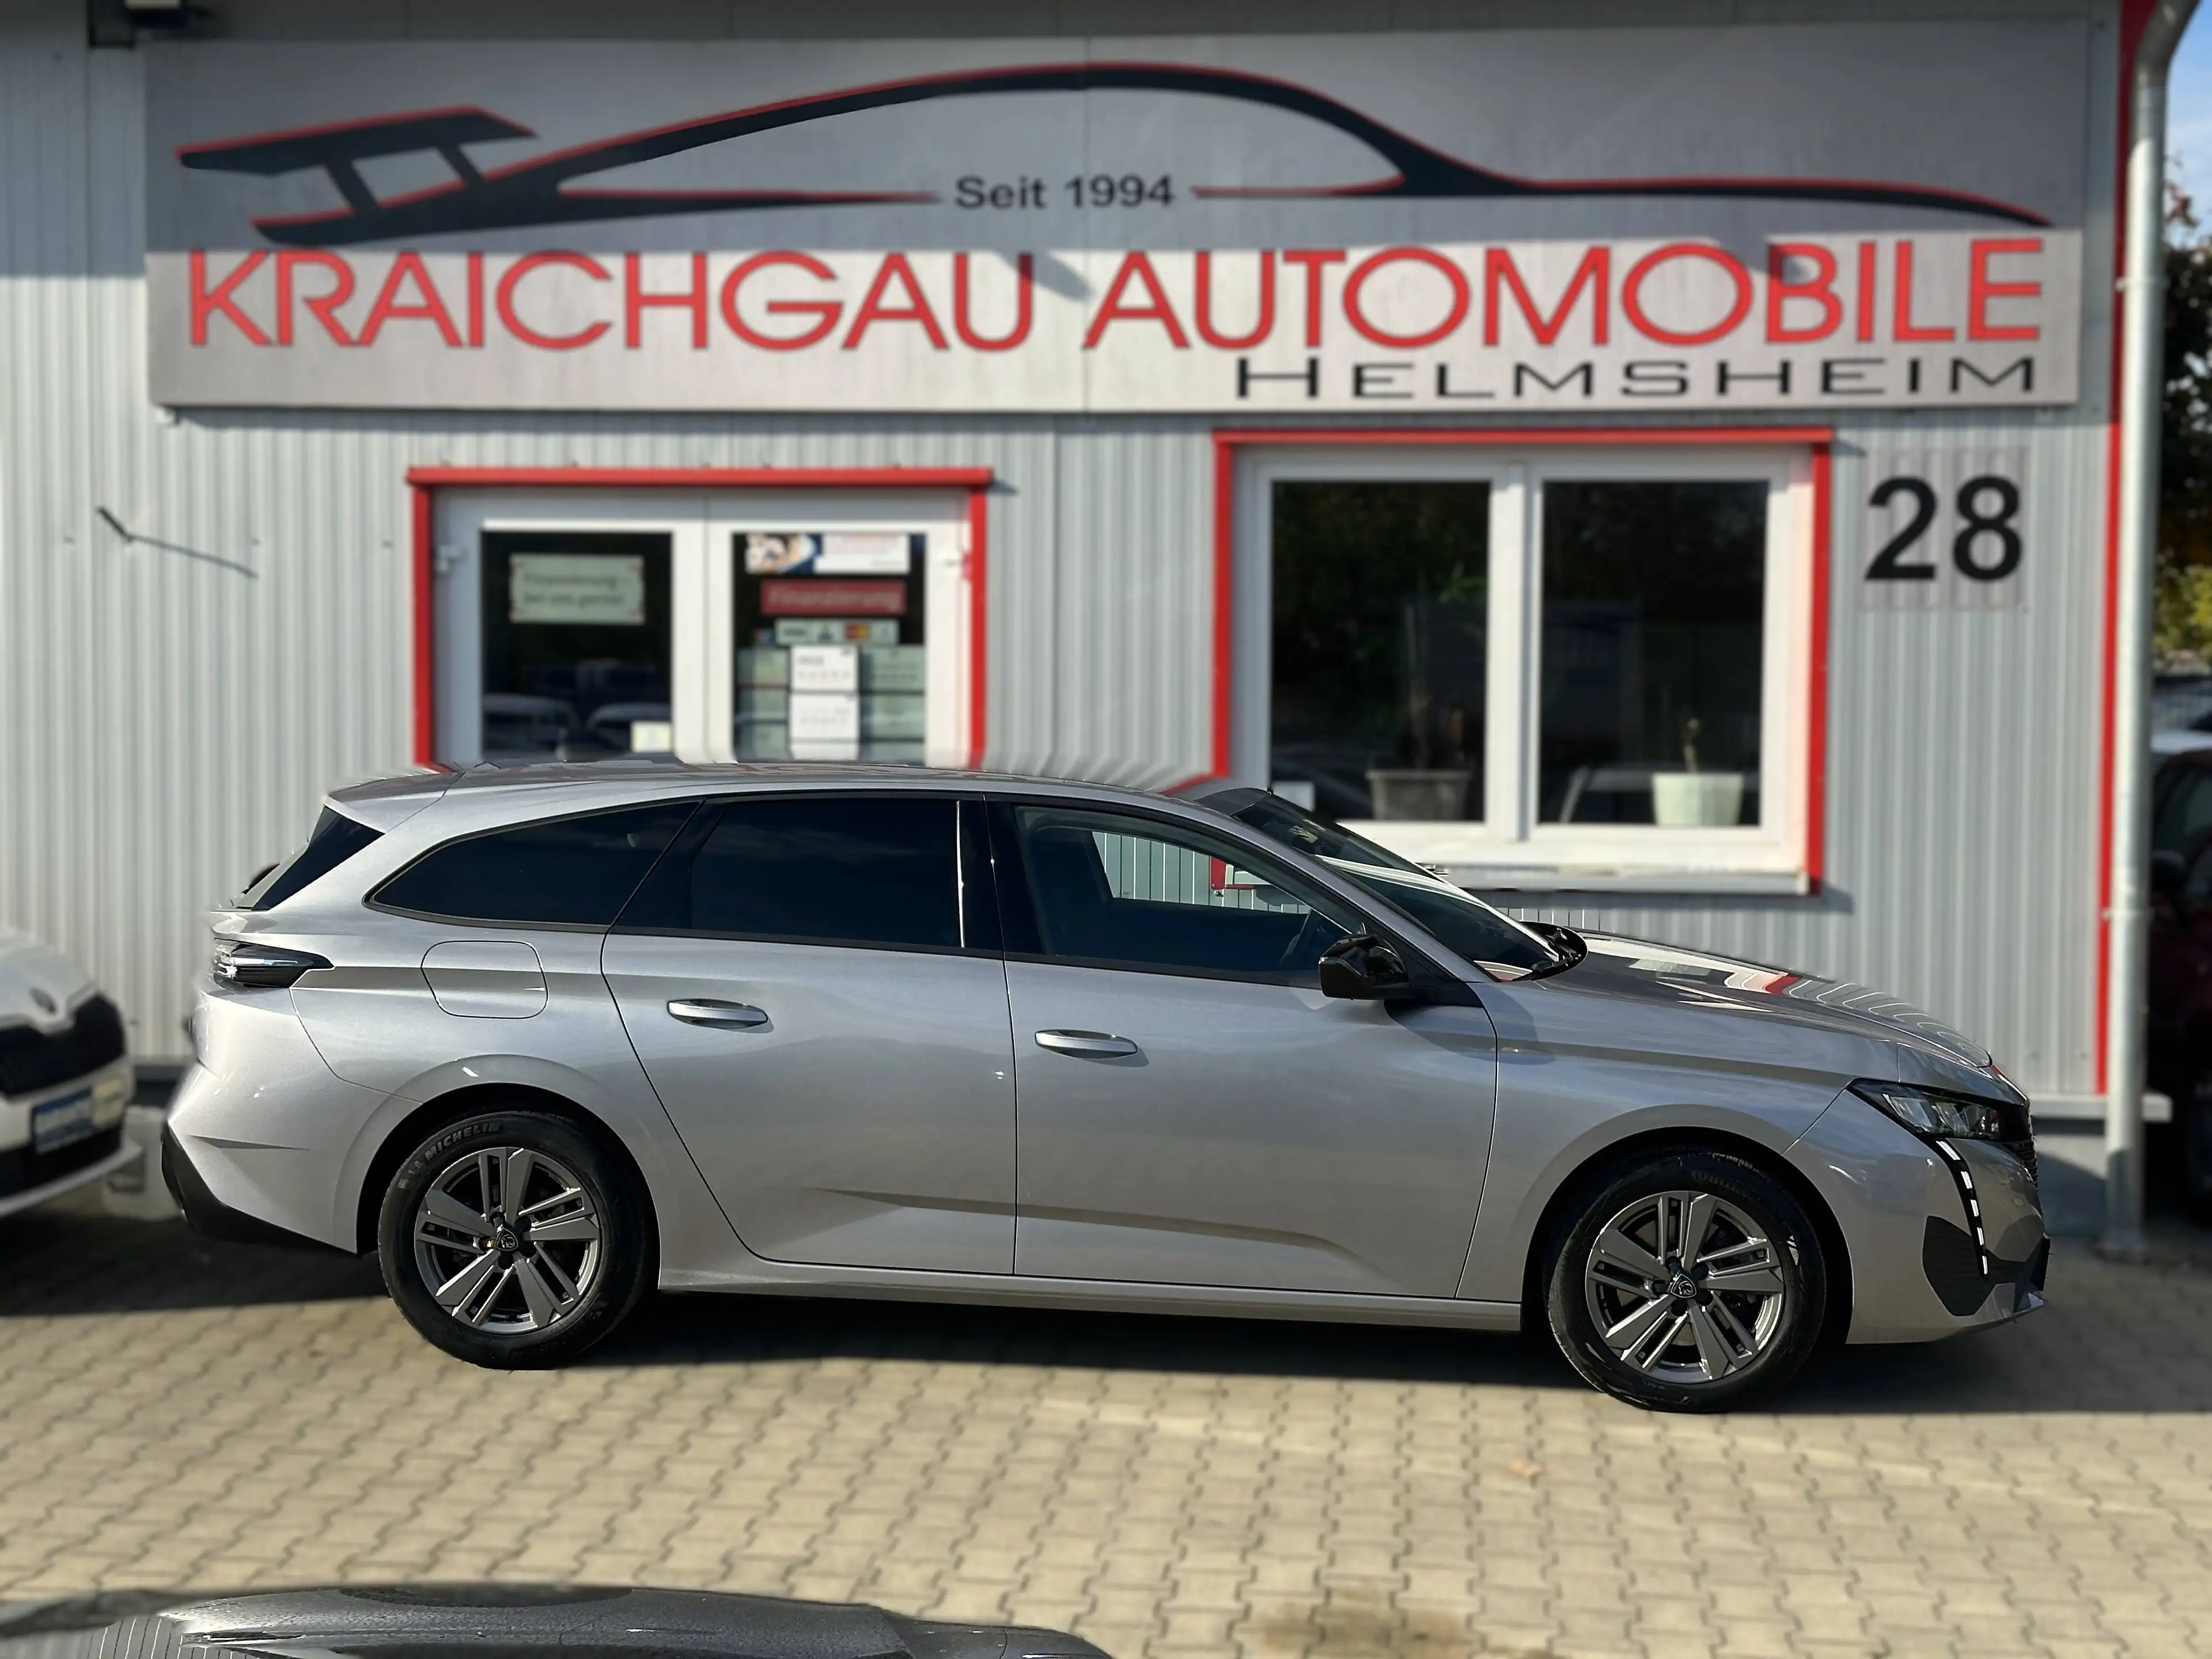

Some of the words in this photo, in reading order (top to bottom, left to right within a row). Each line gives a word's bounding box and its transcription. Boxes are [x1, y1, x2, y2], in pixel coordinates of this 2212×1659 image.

[955, 175, 1047, 209] Seit
[1065, 174, 1175, 208] 1994
[190, 249, 1033, 351] KRAICHGAU
[1082, 238, 2042, 350] AUTOMOBILE
[1237, 355, 2035, 399] HELMSHEIM
[1865, 475, 2023, 582] 28
[425, 1123, 501, 1161] MICHELIN
